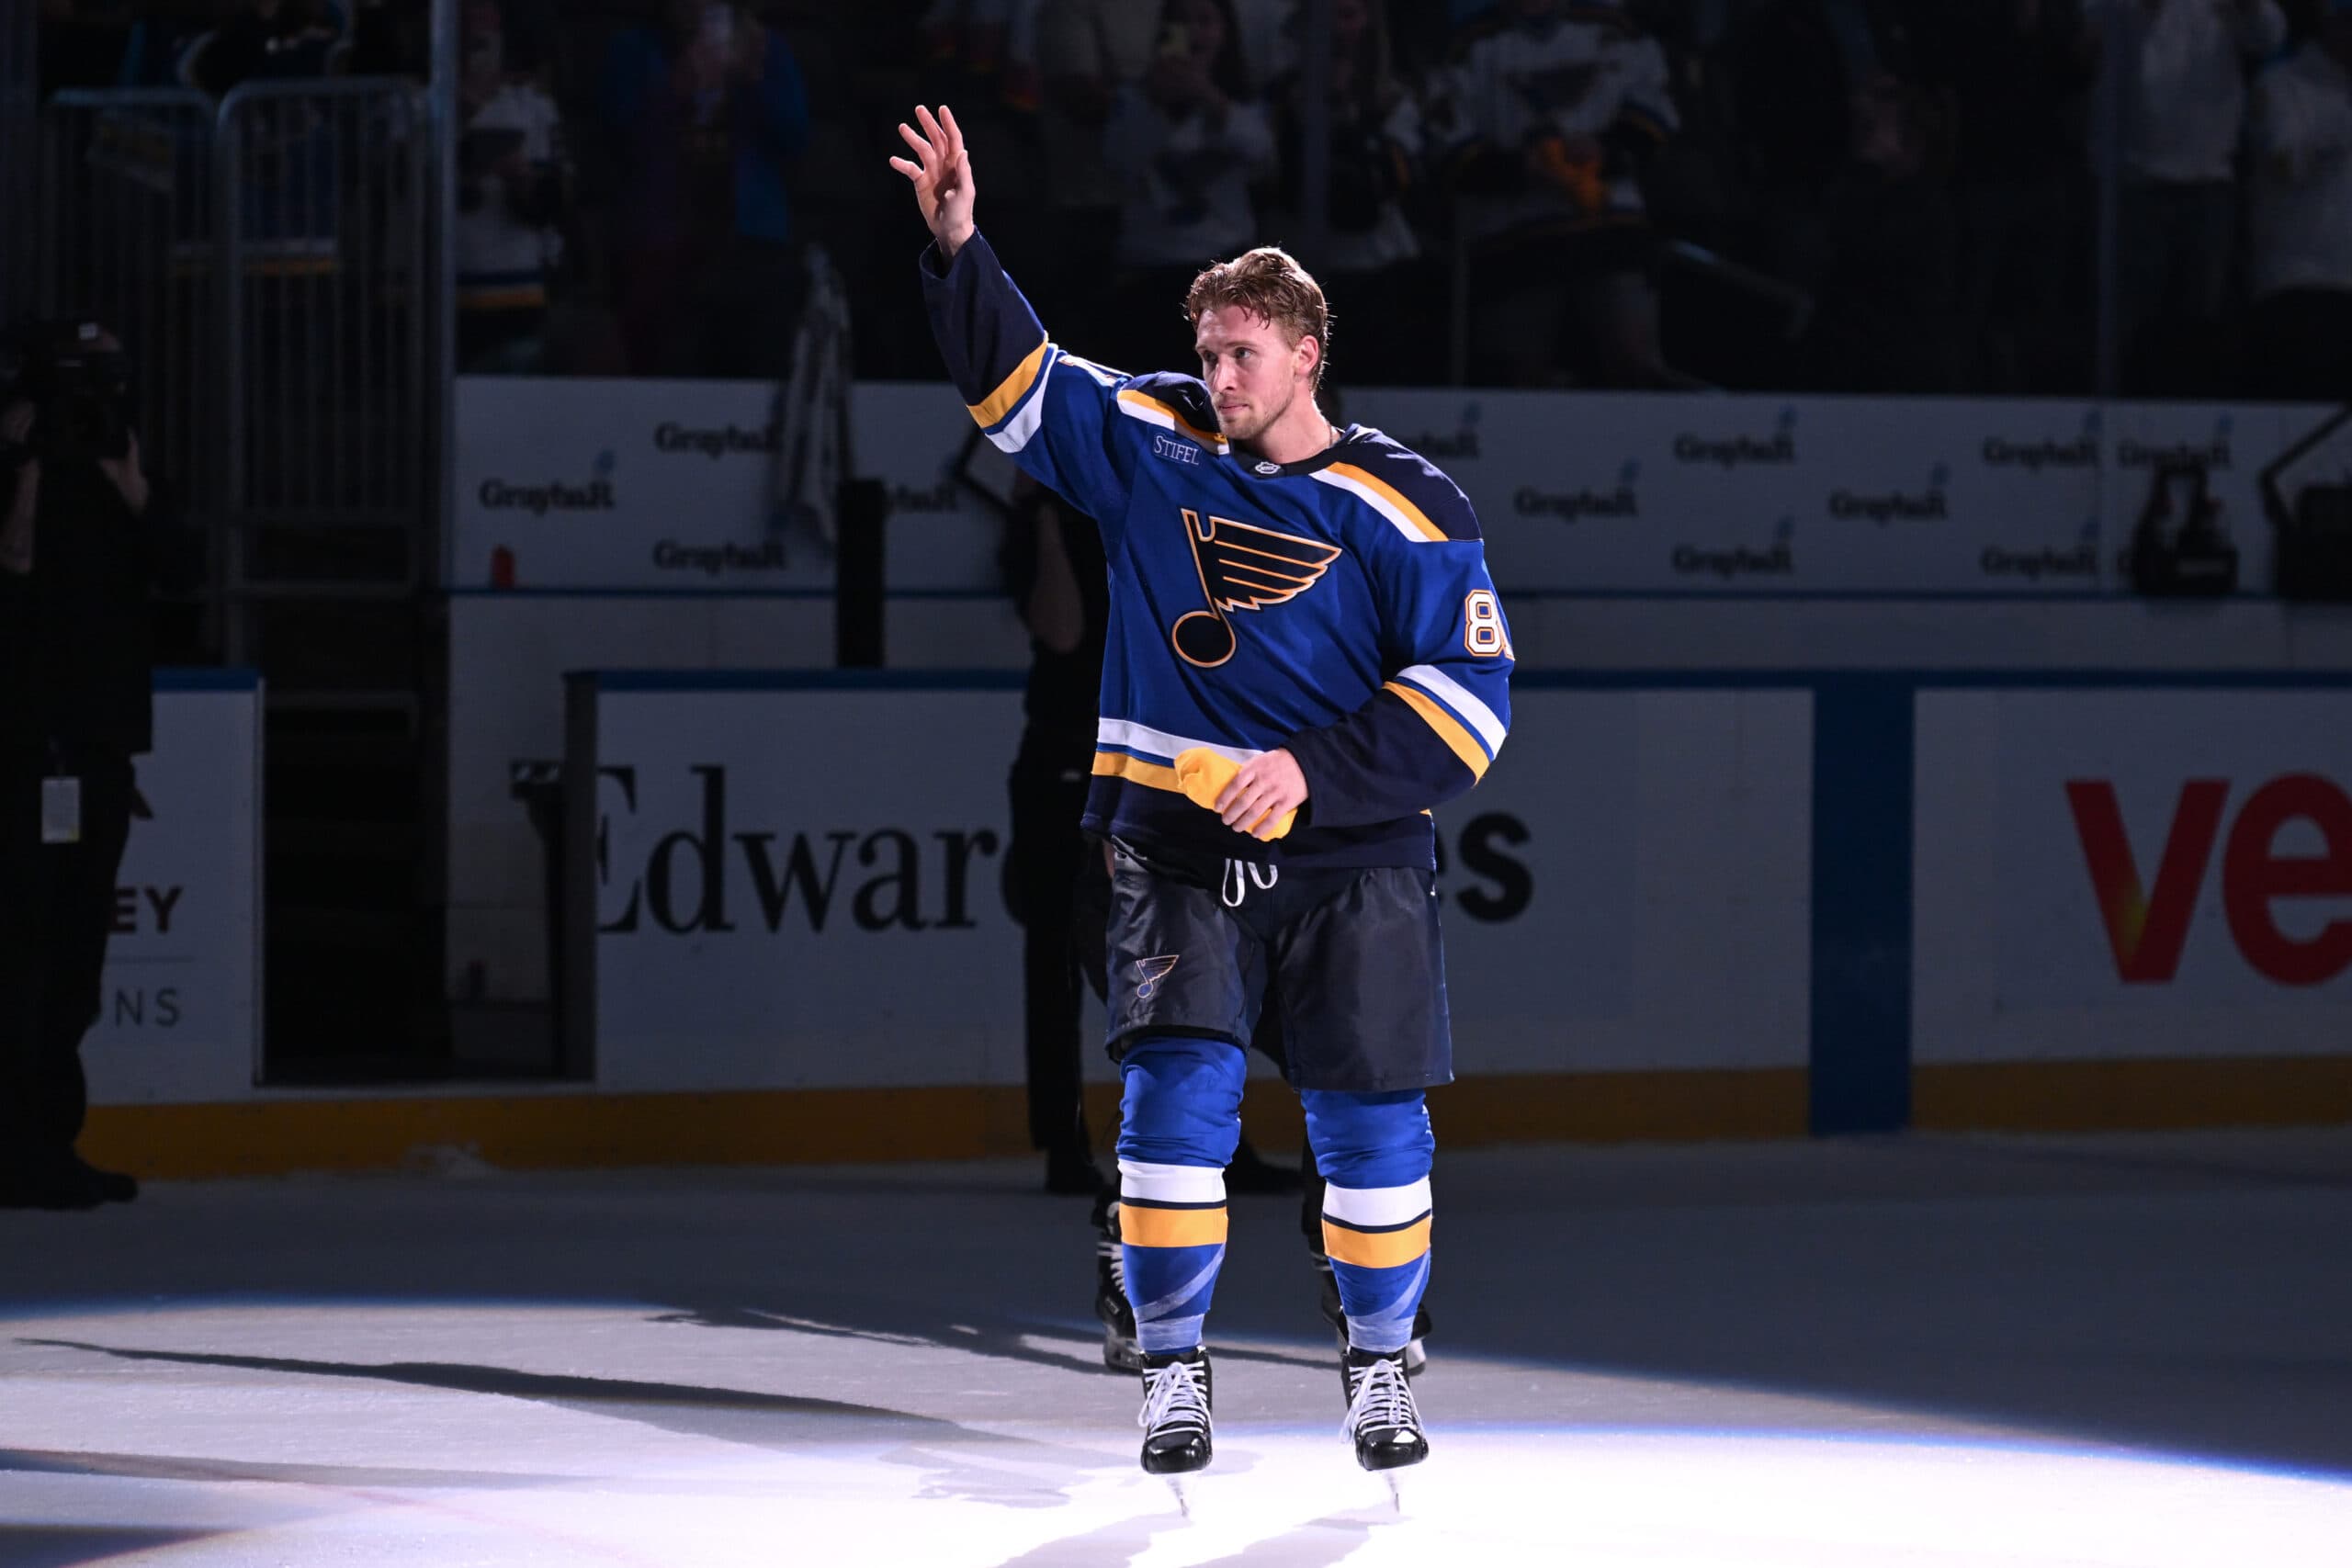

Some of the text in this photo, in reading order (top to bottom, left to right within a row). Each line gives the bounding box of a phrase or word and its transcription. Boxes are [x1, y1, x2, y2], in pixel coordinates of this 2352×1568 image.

[1154, 434, 1199, 466] STIFEL
[1464, 589, 1514, 660] 8
[597, 765, 1023, 934] Edwar
[2064, 772, 2352, 988] ve
[105, 886, 182, 934] EY
[115, 987, 180, 1028] NS
